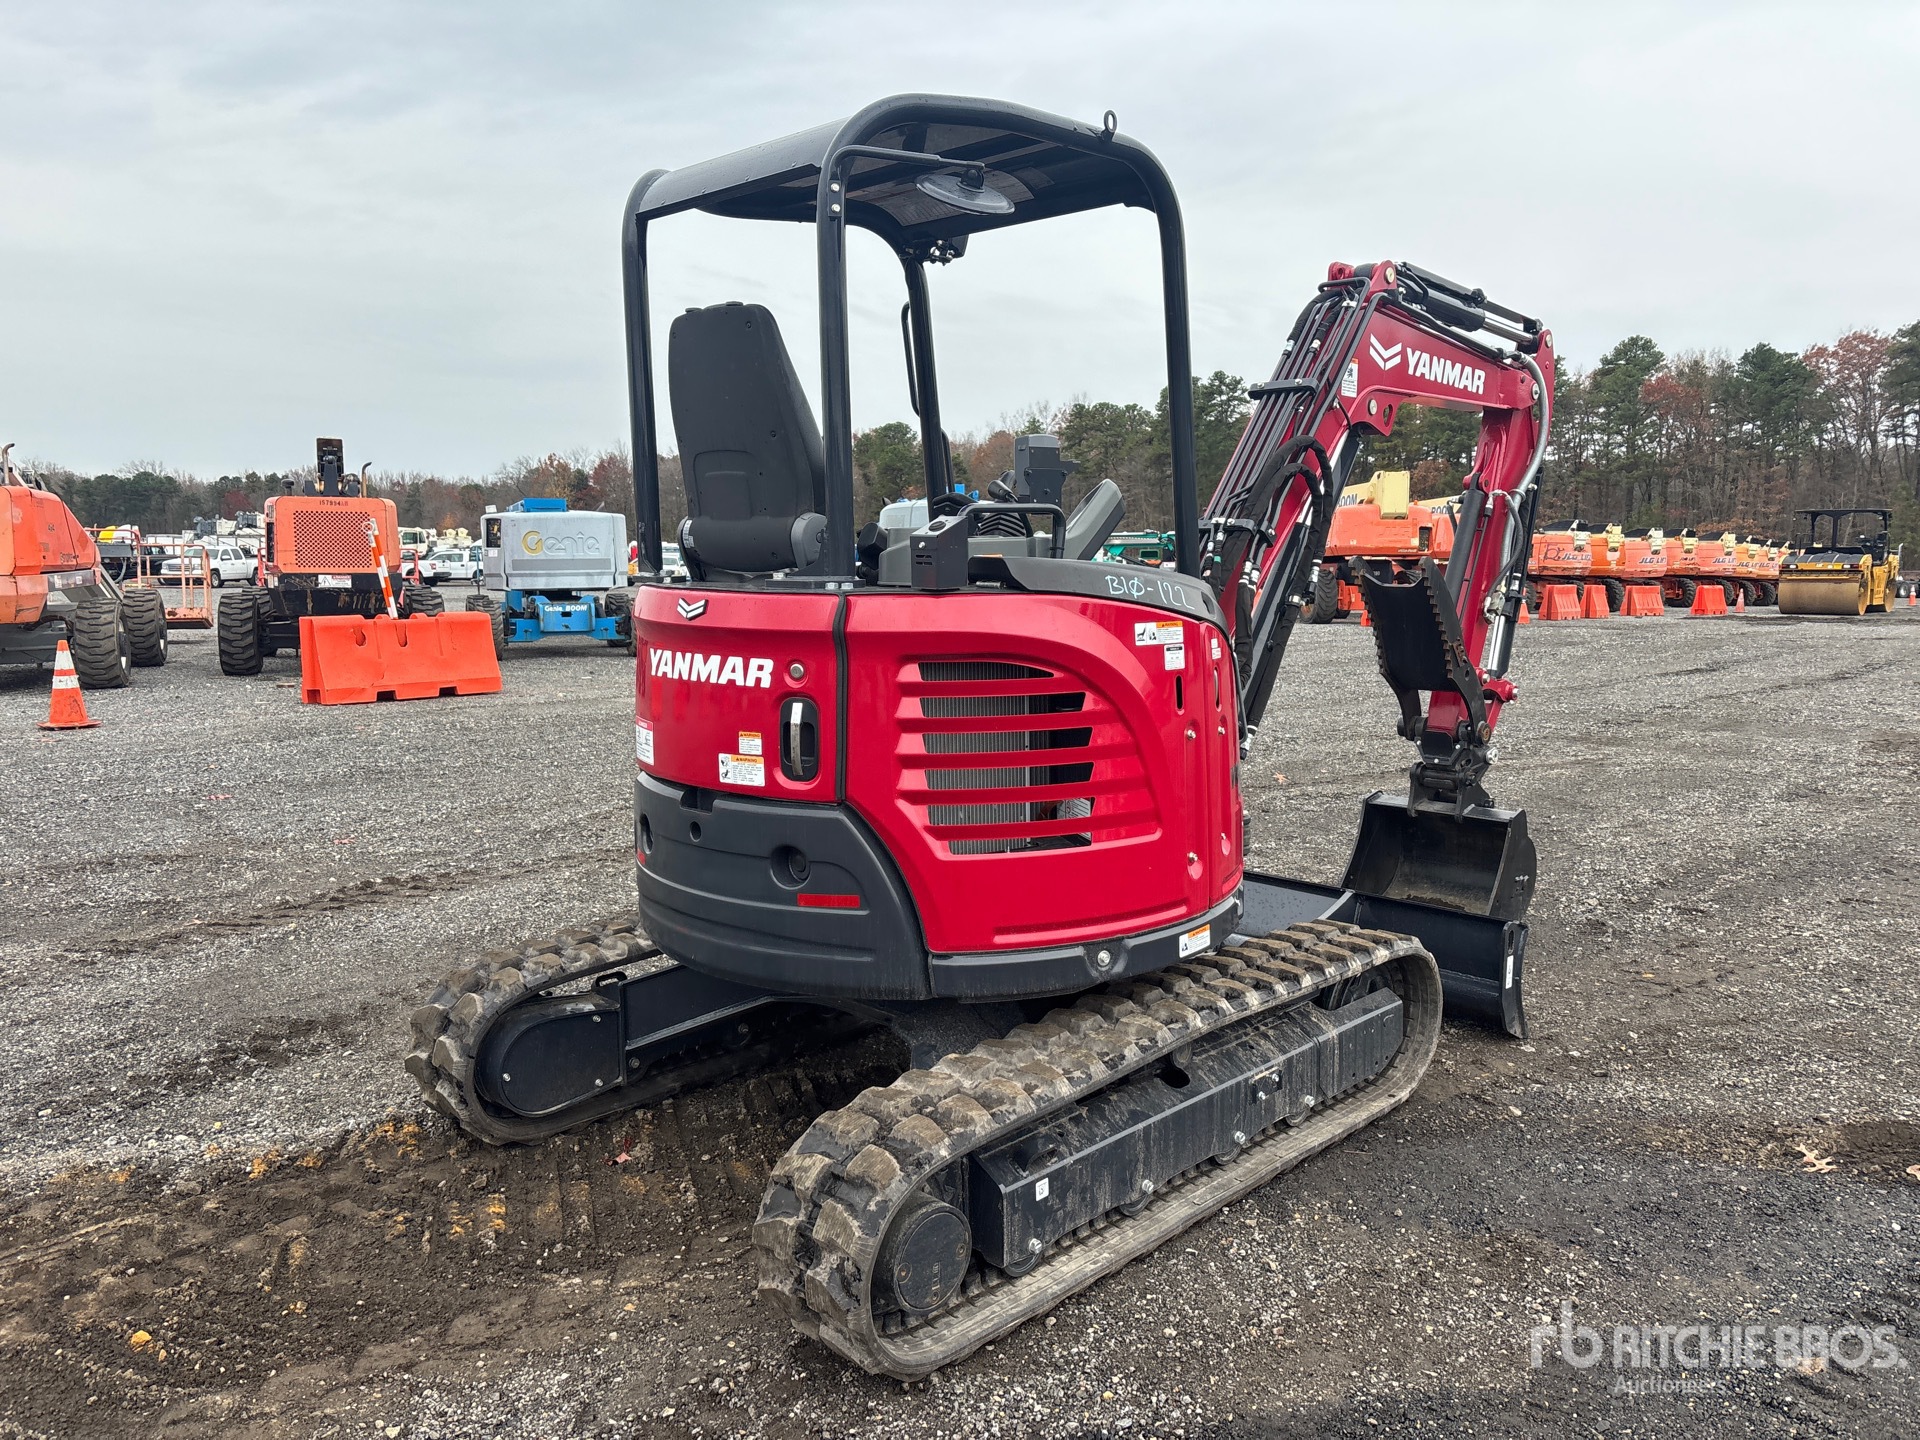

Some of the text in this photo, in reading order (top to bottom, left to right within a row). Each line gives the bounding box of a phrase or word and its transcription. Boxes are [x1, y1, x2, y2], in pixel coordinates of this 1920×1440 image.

[1406, 347, 1486, 395] YANMAR
[521, 530, 601, 556] Genie
[565, 604, 588, 612] BOOM
[649, 647, 774, 689] YANMAR
